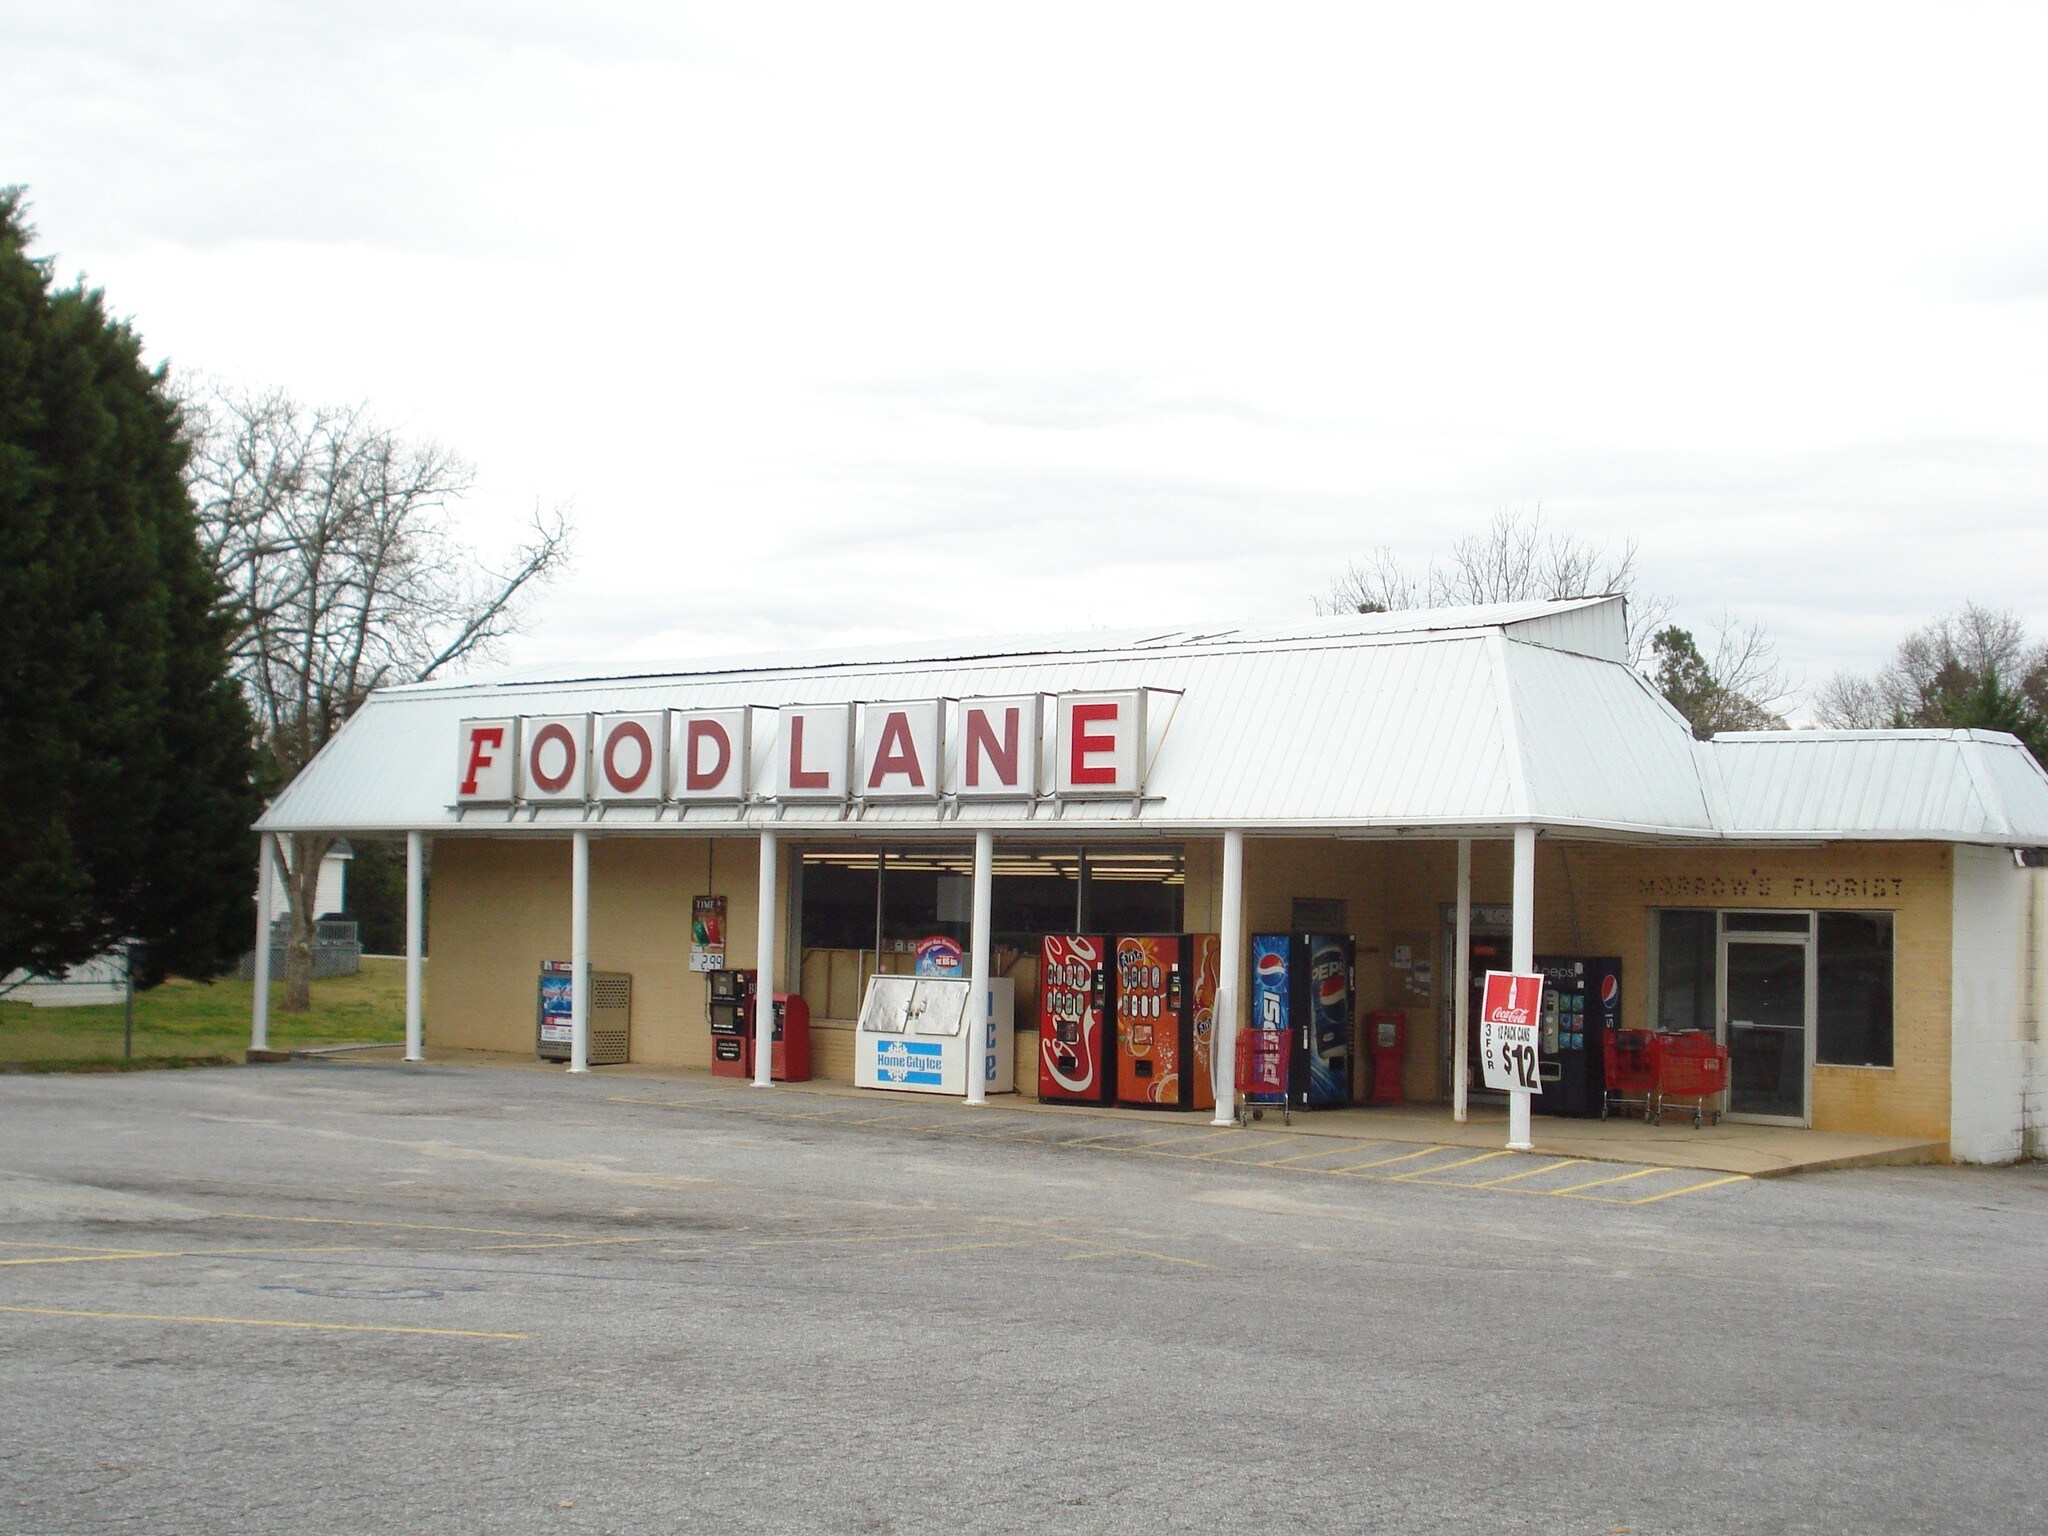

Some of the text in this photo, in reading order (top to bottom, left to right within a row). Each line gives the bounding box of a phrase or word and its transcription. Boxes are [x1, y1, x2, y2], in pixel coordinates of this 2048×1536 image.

[458, 703, 1119, 795] FOOD LANE
[1793, 878, 1902, 896] FLORIST
[697, 900, 715, 909] TIME
[701, 954, 723, 971] 2.99
[1118, 948, 1144, 971] Fanta
[1263, 990, 1280, 1086] PEPSI
[1485, 1023, 1492, 1037] 3
[1497, 1025, 1531, 1042] 12 PACK CANS
[878, 1054, 942, 1071] Home City Ice
[1502, 1042, 1538, 1089] $12
